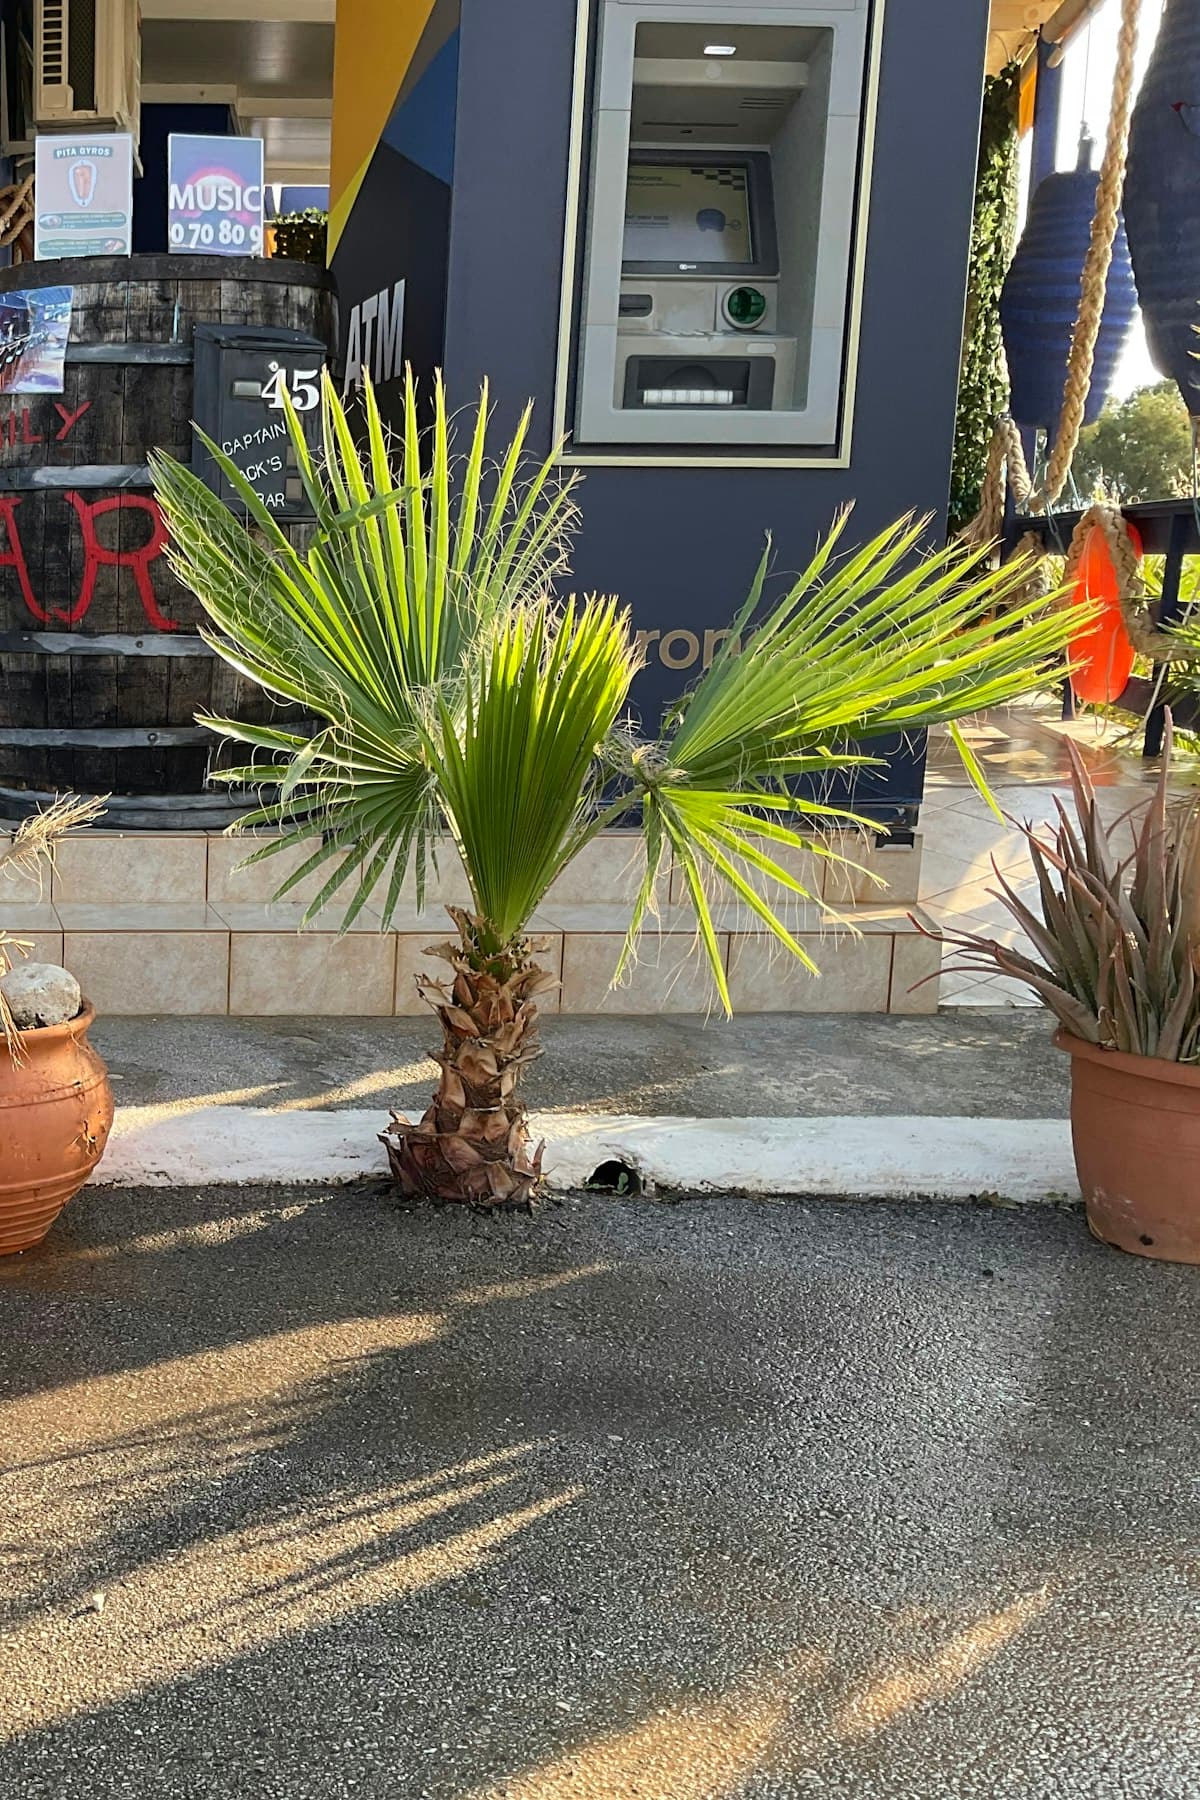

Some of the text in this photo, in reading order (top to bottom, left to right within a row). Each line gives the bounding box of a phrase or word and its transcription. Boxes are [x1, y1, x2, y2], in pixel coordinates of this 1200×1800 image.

[56, 147, 111, 158] PITA GYROS
[169, 183, 261, 212] MUSIC
[168, 223, 185, 244] 0
[188, 223, 214, 249] 70
[218, 219, 245, 245] 80
[344, 278, 406, 397] ATM
[261, 367, 320, 411] 45
[221, 421, 288, 457] CAPTAIN
[229, 455, 283, 488] ACK'S
[632, 628, 758, 669] ron
